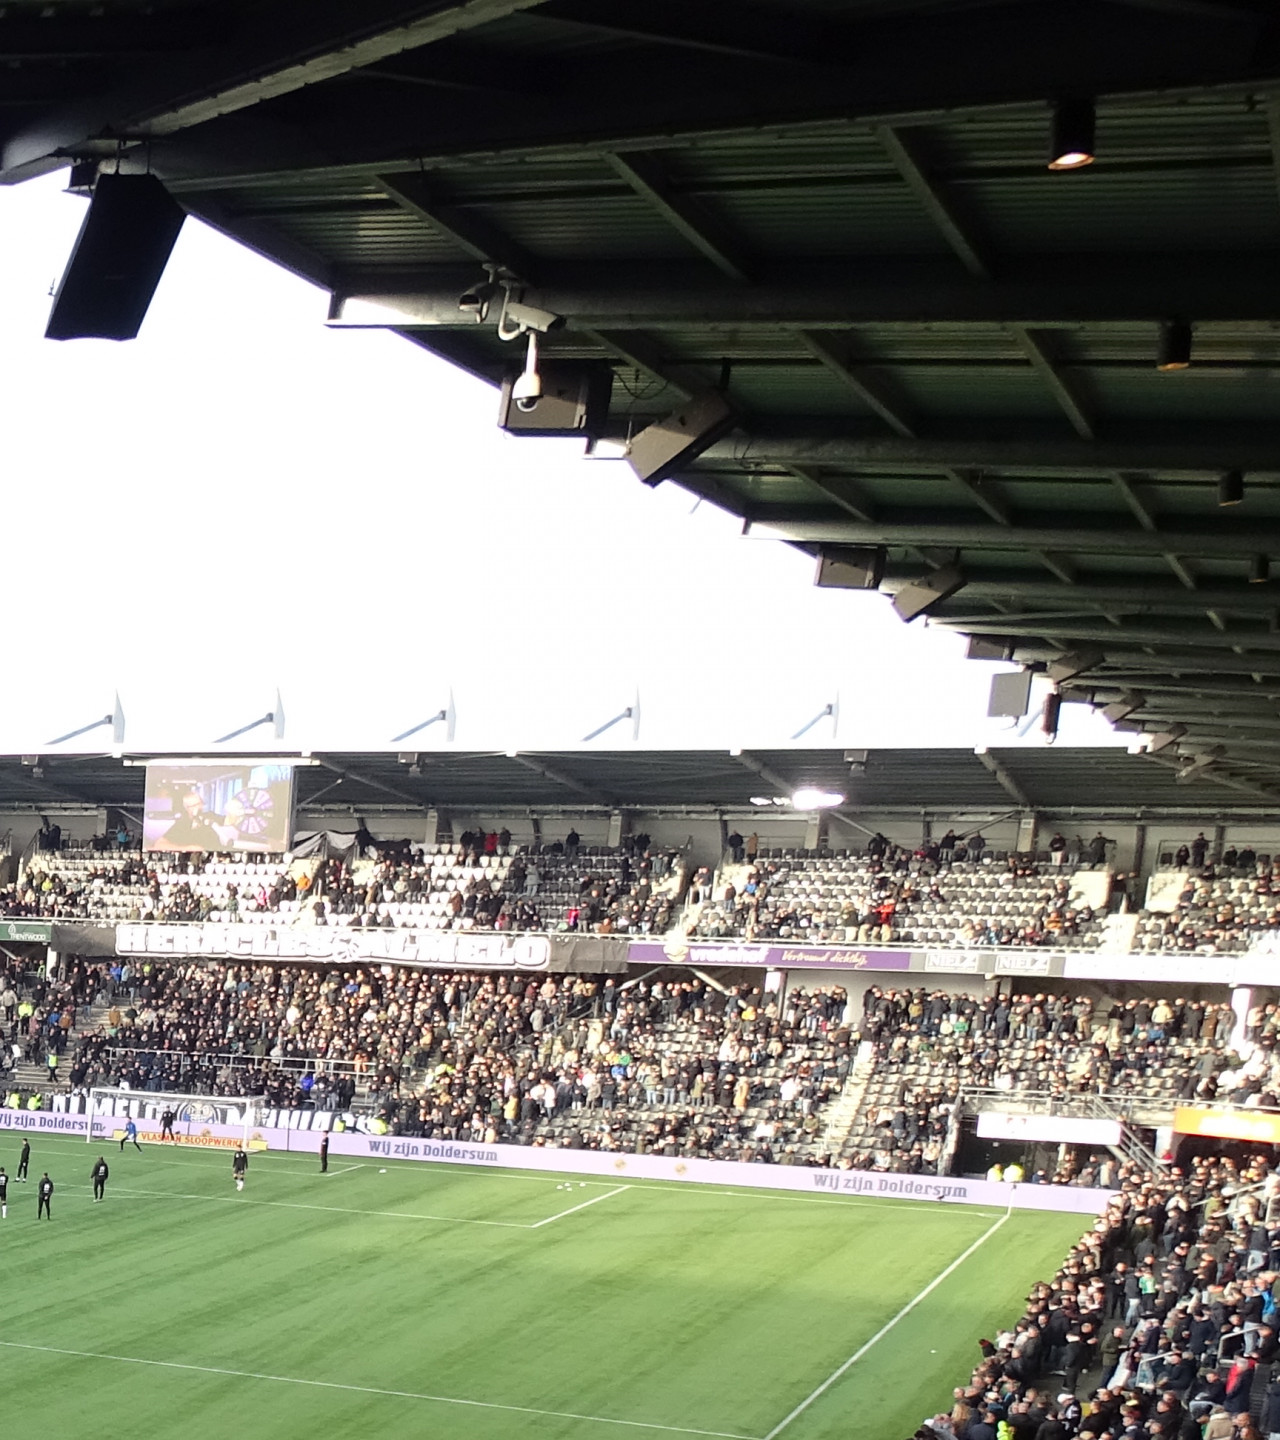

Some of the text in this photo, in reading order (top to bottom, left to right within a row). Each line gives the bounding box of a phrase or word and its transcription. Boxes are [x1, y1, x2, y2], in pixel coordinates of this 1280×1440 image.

[14, 1114, 36, 1128] zijn
[369, 1140, 498, 1162] Wij zijn Doldersum
[813, 1174, 968, 1198] Wij zijn Doldersum
